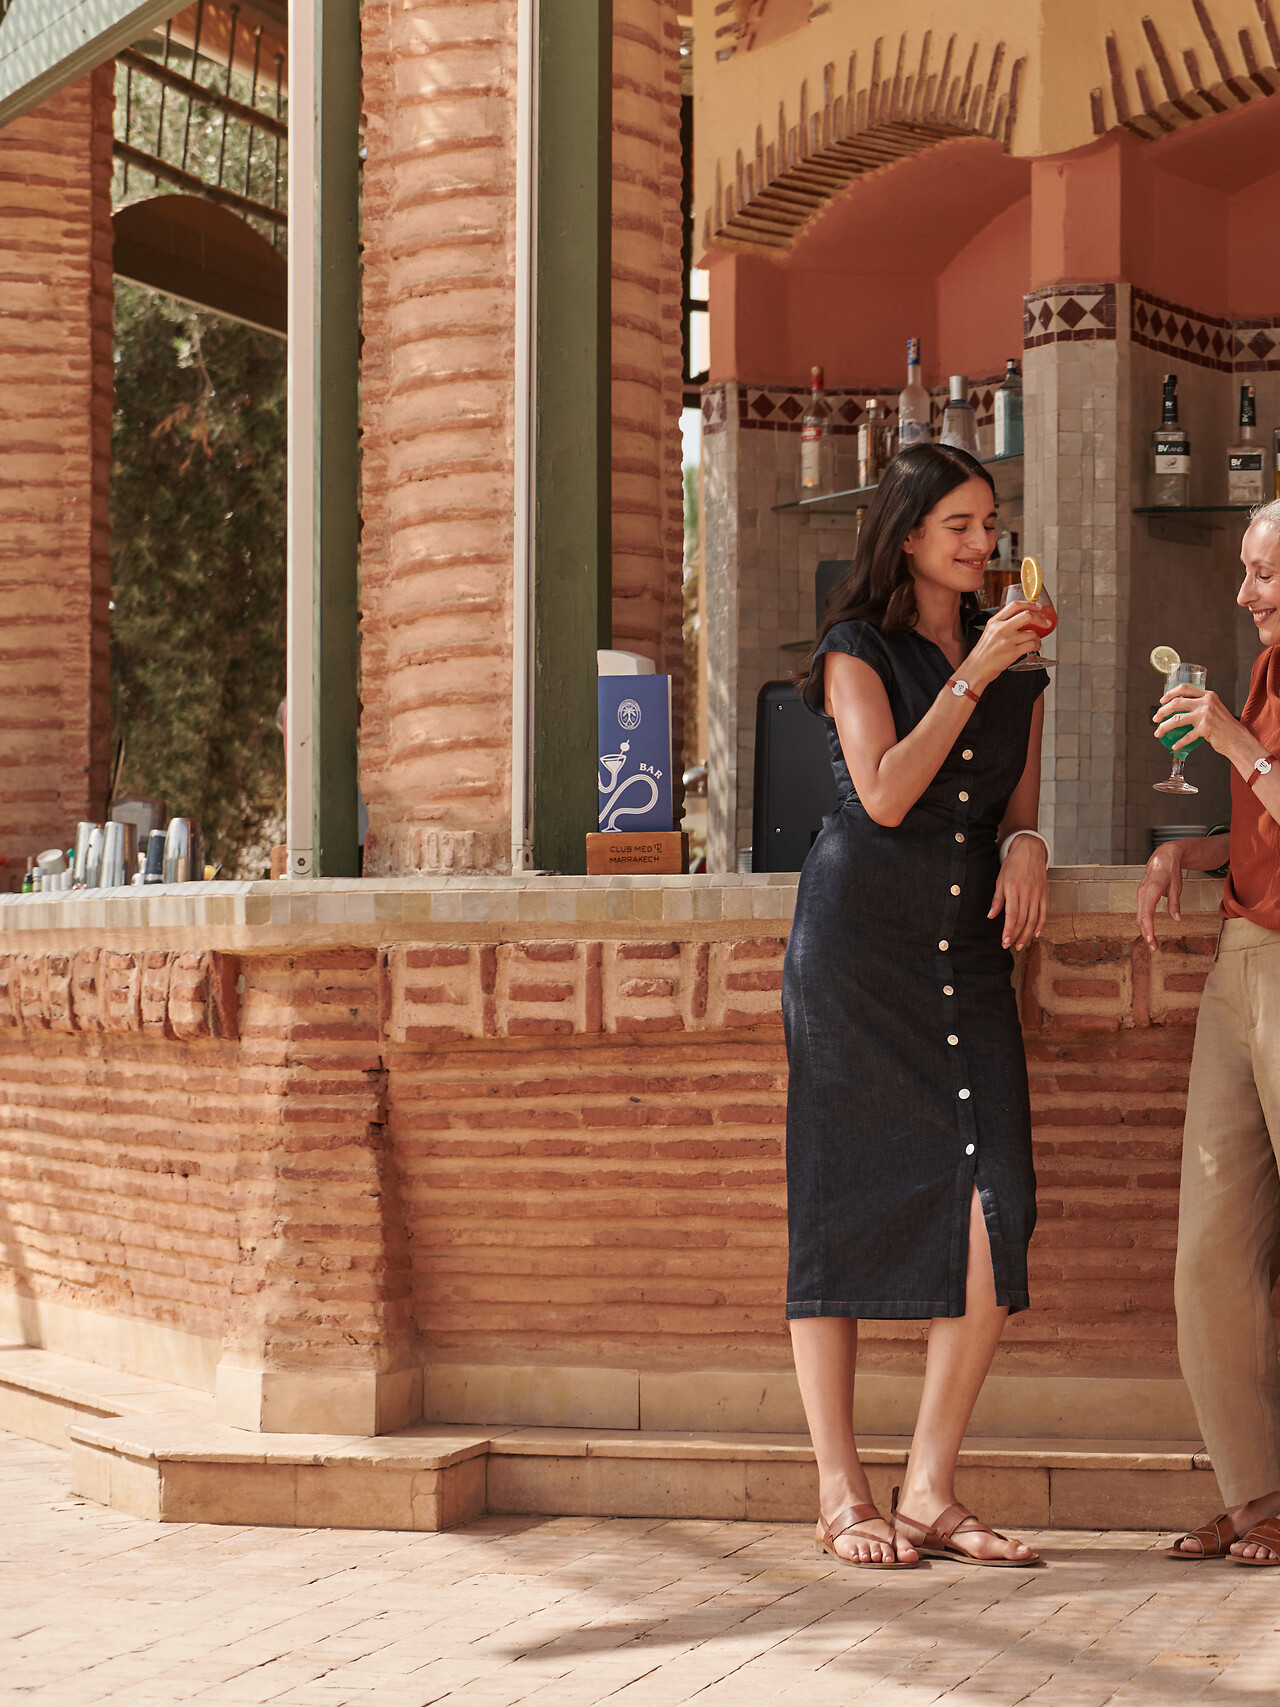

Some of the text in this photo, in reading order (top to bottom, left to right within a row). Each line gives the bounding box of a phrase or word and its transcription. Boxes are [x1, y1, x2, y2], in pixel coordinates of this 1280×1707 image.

[639, 762, 662, 780] BAR
[610, 844, 652, 853] CLUB MED
[609, 855, 660, 864] MARRAKECH
